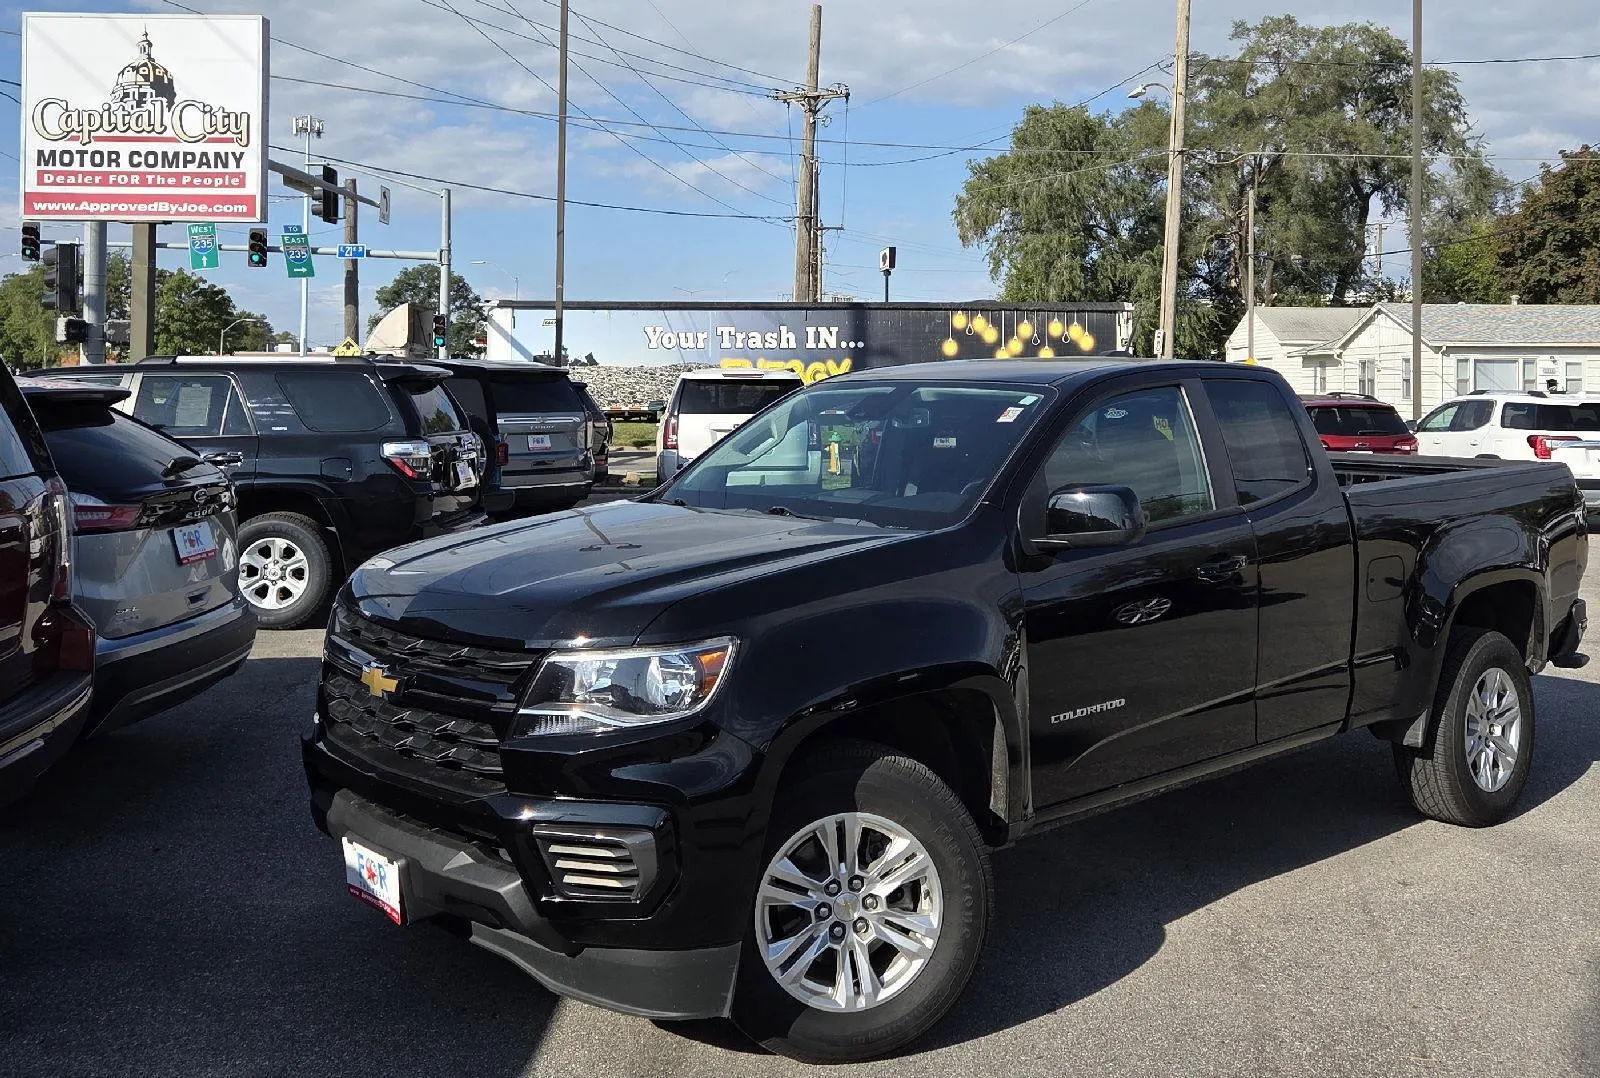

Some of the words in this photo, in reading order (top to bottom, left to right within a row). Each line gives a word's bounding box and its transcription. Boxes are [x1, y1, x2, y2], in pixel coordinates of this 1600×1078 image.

[32, 97, 168, 146] Capital
[171, 99, 251, 148] City
[36, 149, 121, 168] MOTOR
[128, 150, 245, 169] COMPANY
[43, 173, 103, 184] Dealer
[108, 174, 141, 185] FOR
[145, 175, 177, 185] The
[32, 201, 248, 215] www.ApprovedByJoe.com
[190, 225, 213, 234] WEST
[194, 239, 213, 249] 235
[284, 236, 306, 244] EAST
[289, 250, 308, 259] 235
[643, 326, 708, 350] Your
[715, 325, 797, 350] Trash
[804, 326, 865, 350] IN...
[1050, 698, 1126, 724] COLORADO
